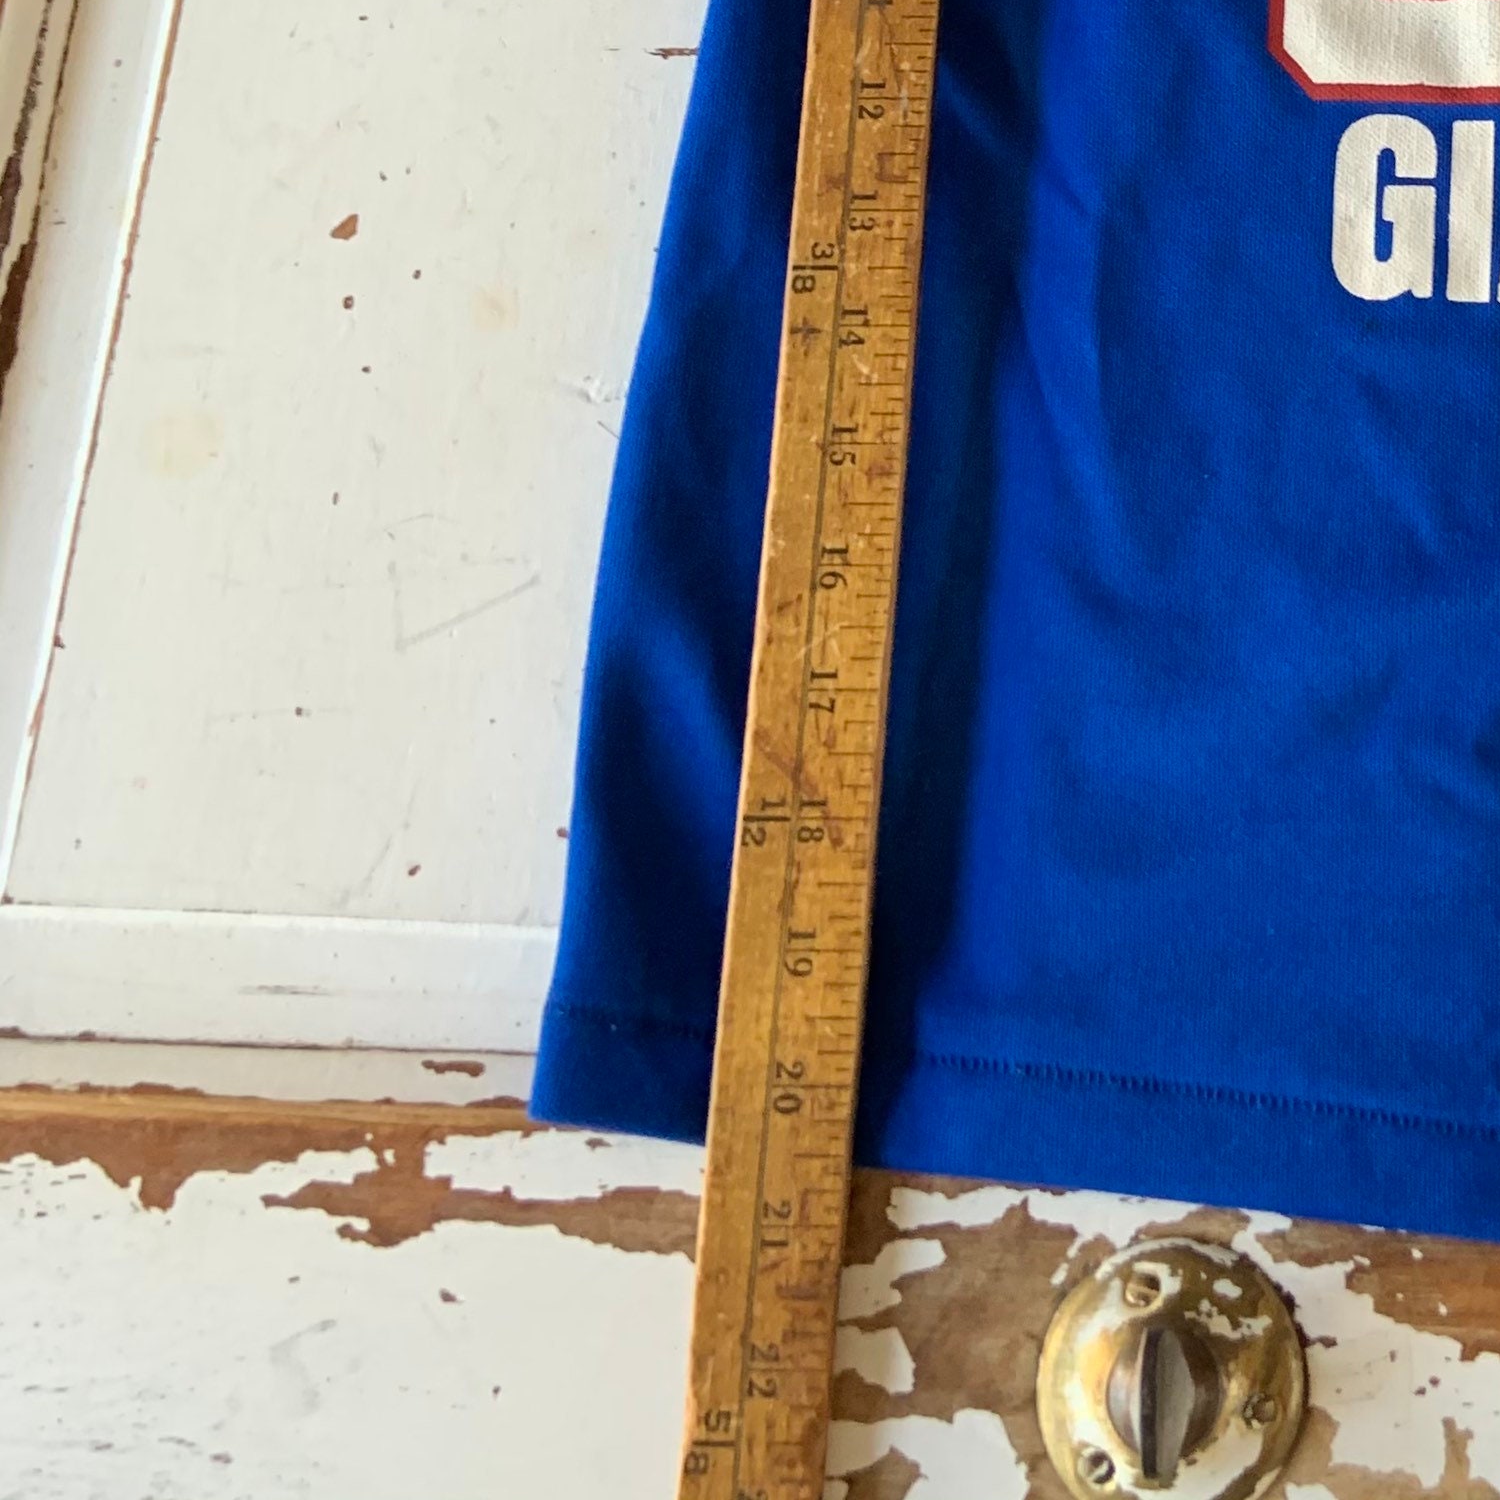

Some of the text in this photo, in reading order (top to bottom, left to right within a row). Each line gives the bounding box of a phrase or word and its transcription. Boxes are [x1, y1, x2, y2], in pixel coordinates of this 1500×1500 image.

[857, 80, 887, 121] 12
[847, 190, 878, 232] 13
[838, 305, 868, 348] 14
[828, 423, 858, 466] 15
[818, 544, 849, 590] 16
[808, 669, 838, 714] 17
[797, 799, 827, 844] 18
[784, 926, 817, 978] 19
[773, 1060, 804, 1115] 20
[759, 1200, 791, 1250] 21
[746, 1343, 780, 1399] 22
